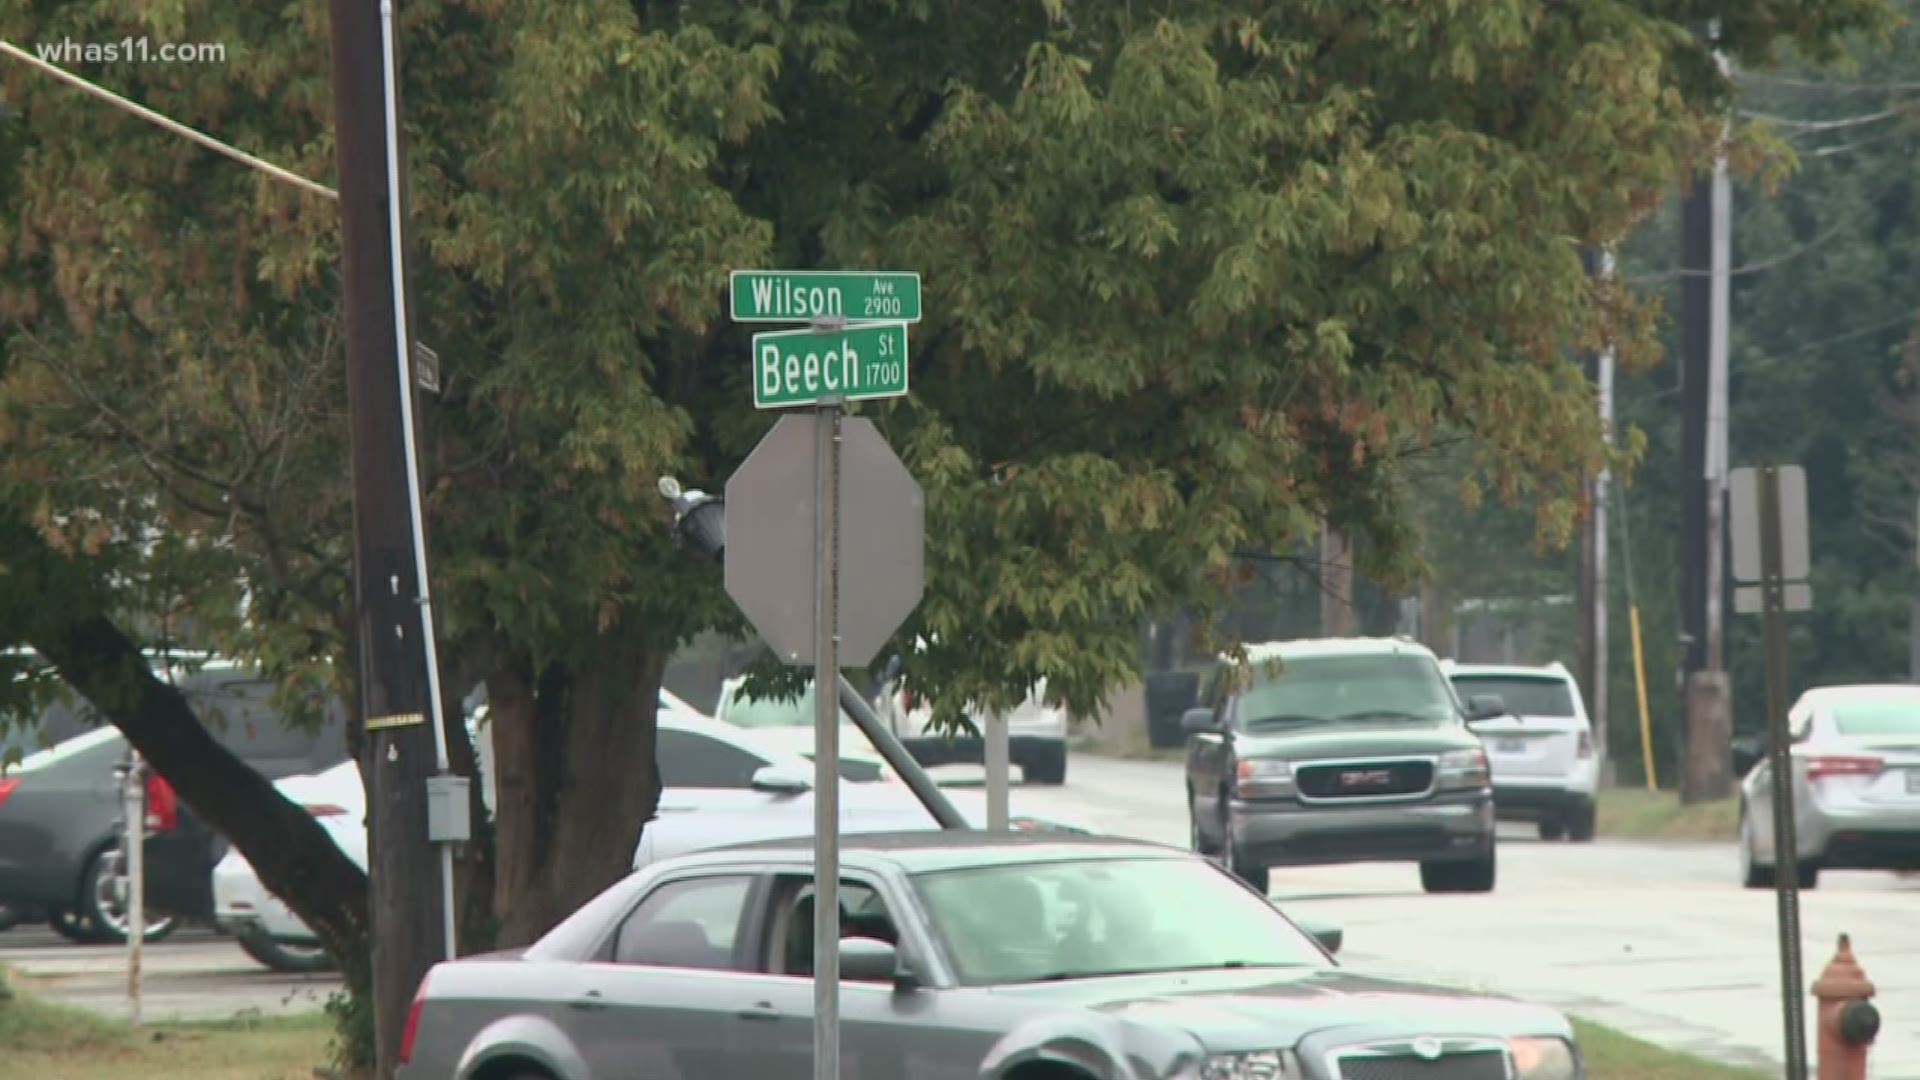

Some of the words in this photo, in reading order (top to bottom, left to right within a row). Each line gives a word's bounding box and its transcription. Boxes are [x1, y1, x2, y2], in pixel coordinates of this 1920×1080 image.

[751, 276, 842, 316] Wilson
[873, 279, 894, 295] Ave
[864, 298, 901, 316] 2900
[878, 333, 895, 356] St
[761, 337, 859, 397] Beech
[866, 361, 900, 387] 1700
